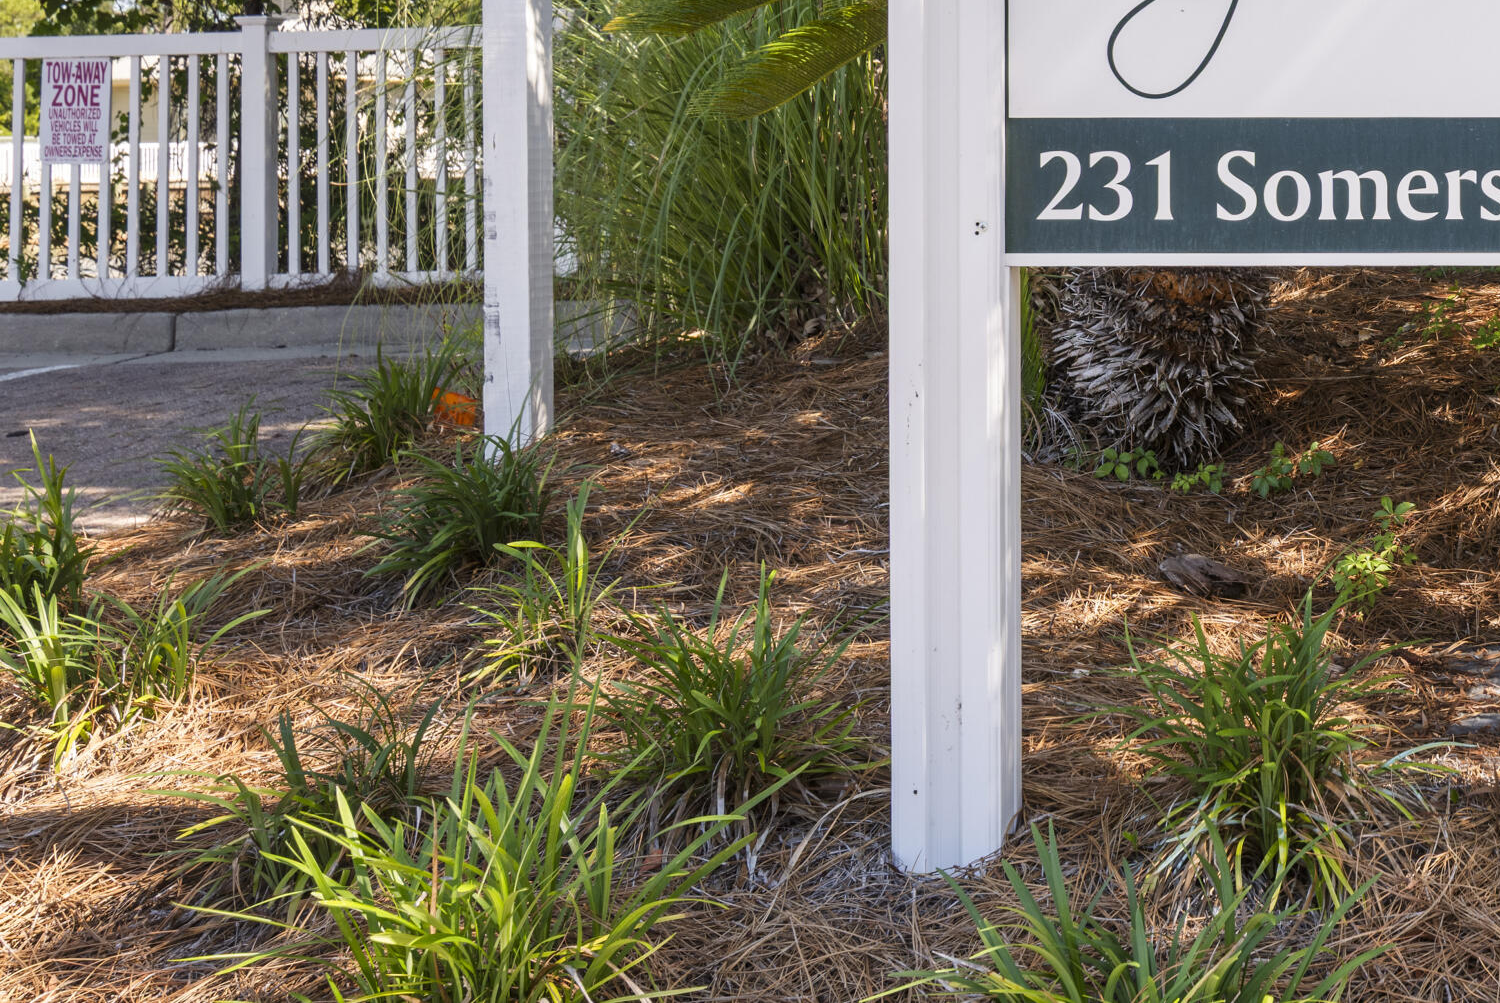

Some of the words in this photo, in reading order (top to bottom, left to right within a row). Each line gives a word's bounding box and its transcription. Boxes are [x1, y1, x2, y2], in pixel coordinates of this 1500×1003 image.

[46, 61, 108, 84] TOW-AWAY
[52, 84, 101, 107] ZONE
[48, 108, 102, 120] UNAUTHORIZED
[50, 120, 81, 133] VEHICLES
[84, 120, 98, 133] WILL
[52, 133, 61, 145] BE
[63, 133, 86, 145] TOWED
[87, 133, 96, 145] AT
[73, 145, 103, 158] EXPENSE
[1036, 150, 1174, 222] 231
